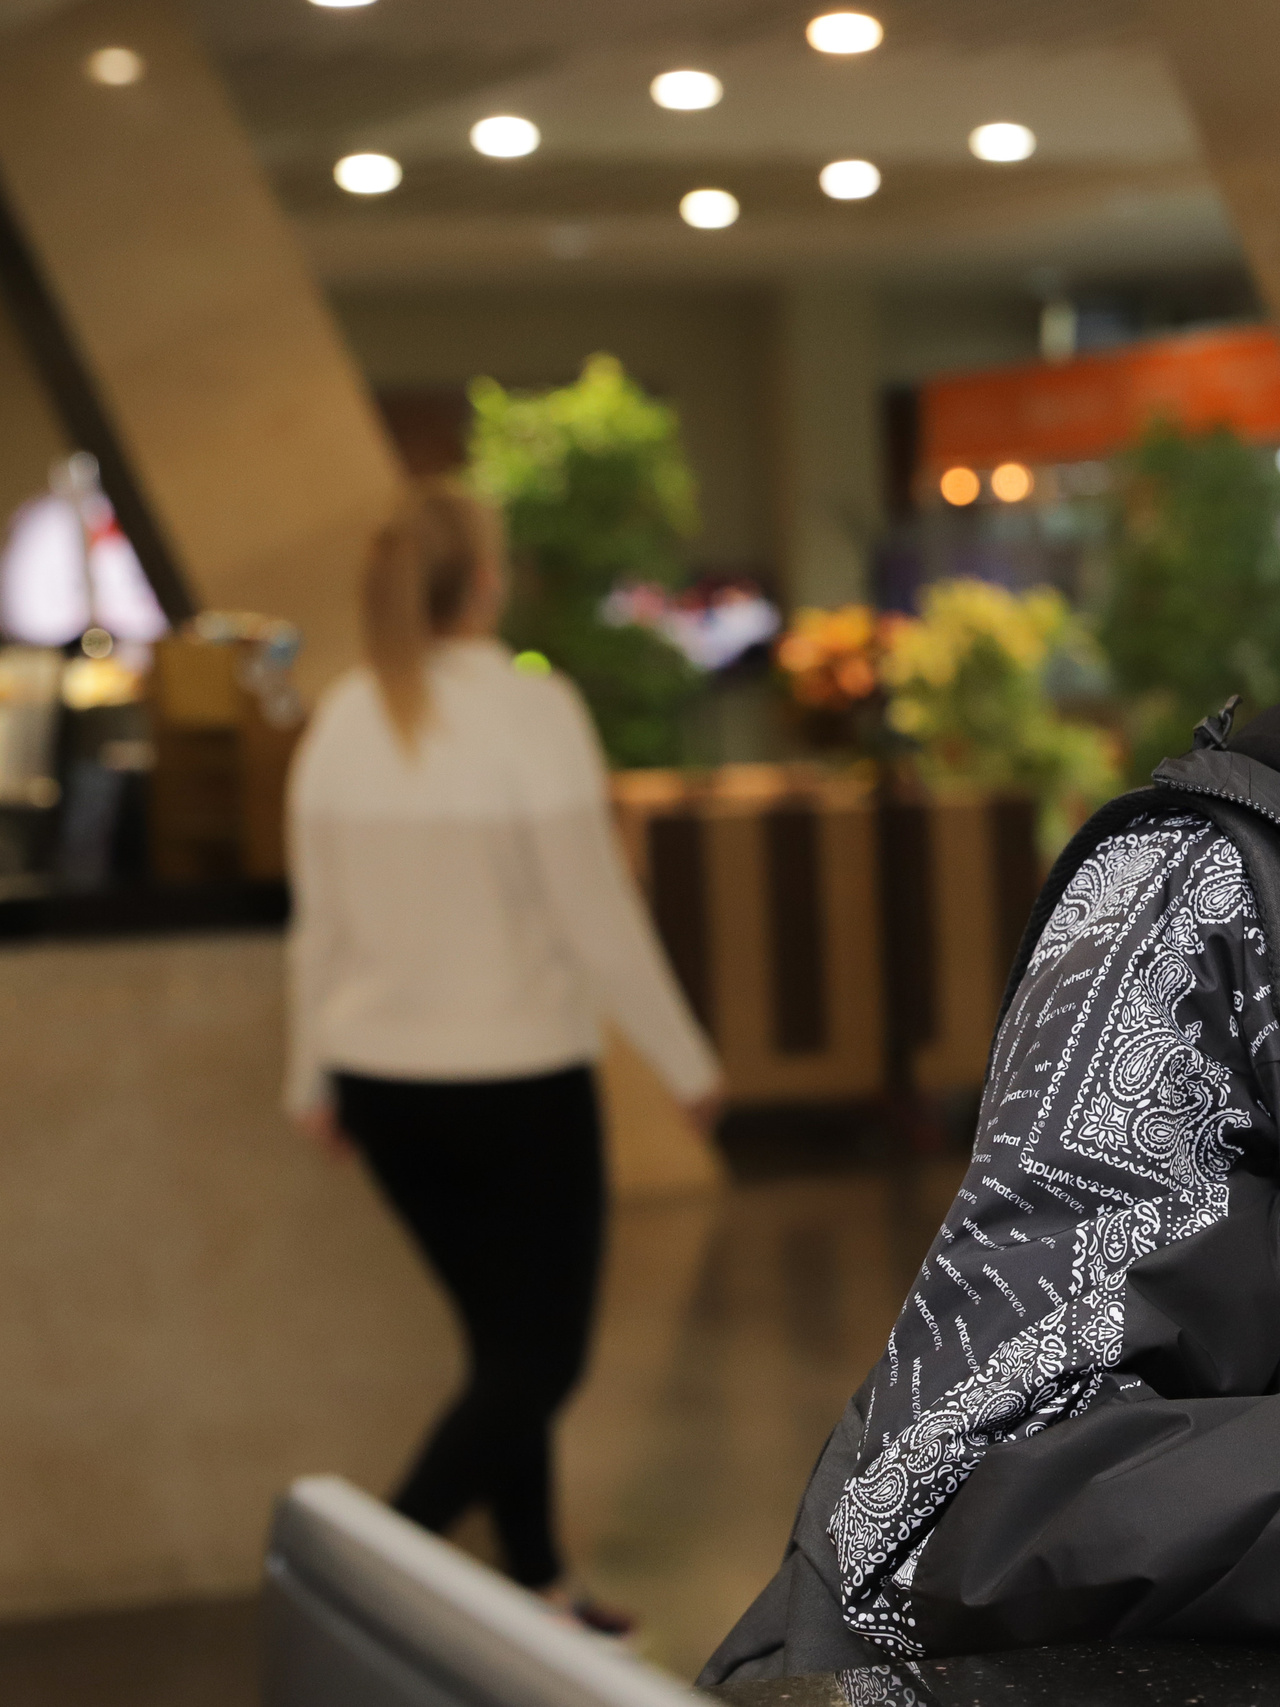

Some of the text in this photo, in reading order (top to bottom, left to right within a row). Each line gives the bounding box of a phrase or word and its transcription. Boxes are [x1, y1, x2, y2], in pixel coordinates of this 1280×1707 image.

[982, 1175, 1035, 1214] whatever
[935, 1253, 982, 1305] whatever
[982, 1263, 1027, 1318] whatever
[914, 1291, 943, 1351] whatever
[911, 1356, 923, 1420] whatever
